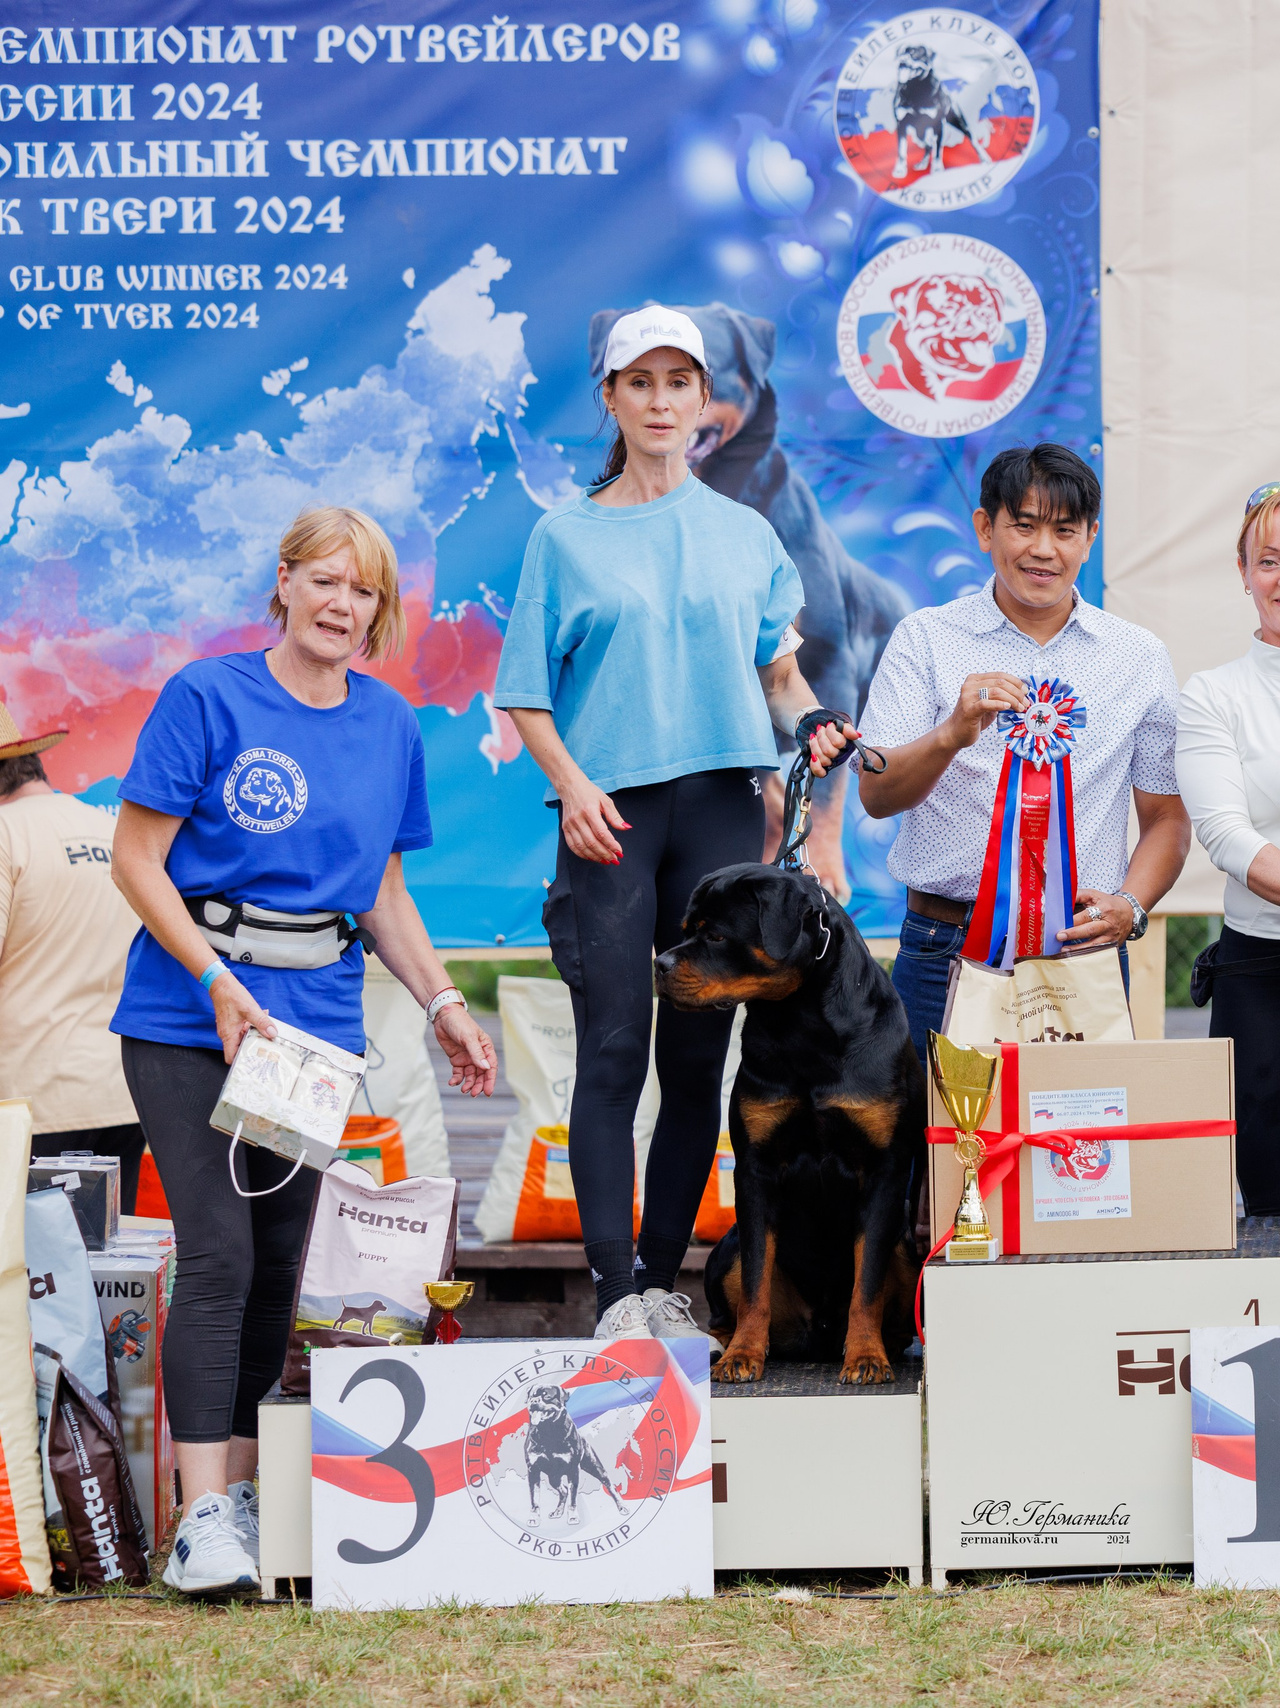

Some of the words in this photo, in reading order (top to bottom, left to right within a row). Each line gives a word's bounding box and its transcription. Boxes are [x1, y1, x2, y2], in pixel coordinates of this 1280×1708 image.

[0, 26, 297, 64] ЕМПИОНАТ
[314, 16, 682, 62] РОТВЕЙЛЕРОВ
[929, 15, 997, 46] КЛУБ
[0, 84, 136, 122] ССИИ
[151, 82, 263, 121] 2024
[0, 132, 269, 179] ОНАЛЬНЫЙ
[286, 137, 628, 177] ЧЕМПИОНАТ
[884, 181, 994, 207] РКФ-НКПР
[42, 197, 216, 235] ТВЕРИ
[234, 196, 345, 234] 2024
[896, 236, 941, 261] 2024
[9, 264, 104, 291] CLUB
[117, 264, 263, 291] WINNER
[274, 264, 348, 290] 2024
[18, 303, 62, 330] OF
[75, 303, 173, 330] TVER
[185, 302, 260, 329] 2024
[640, 325, 682, 339] FILA
[239, 750, 266, 765] DOMA
[267, 751, 298, 774] TORRA
[236, 812, 296, 831] ROTTWEILER
[338, 1201, 428, 1234] Hanta
[361, 1227, 397, 1238] premium
[358, 1251, 388, 1263] PUPPY
[468, 1358, 546, 1508] РОТВЕЙЛЕР
[562, 1353, 634, 1386] КЛУБ
[638, 1390, 676, 1503] РОССИИ
[337, 1358, 436, 1565] 3
[80, 1476, 124, 1582] Hanta
[518, 1522, 632, 1559] РКФ-НКПР
